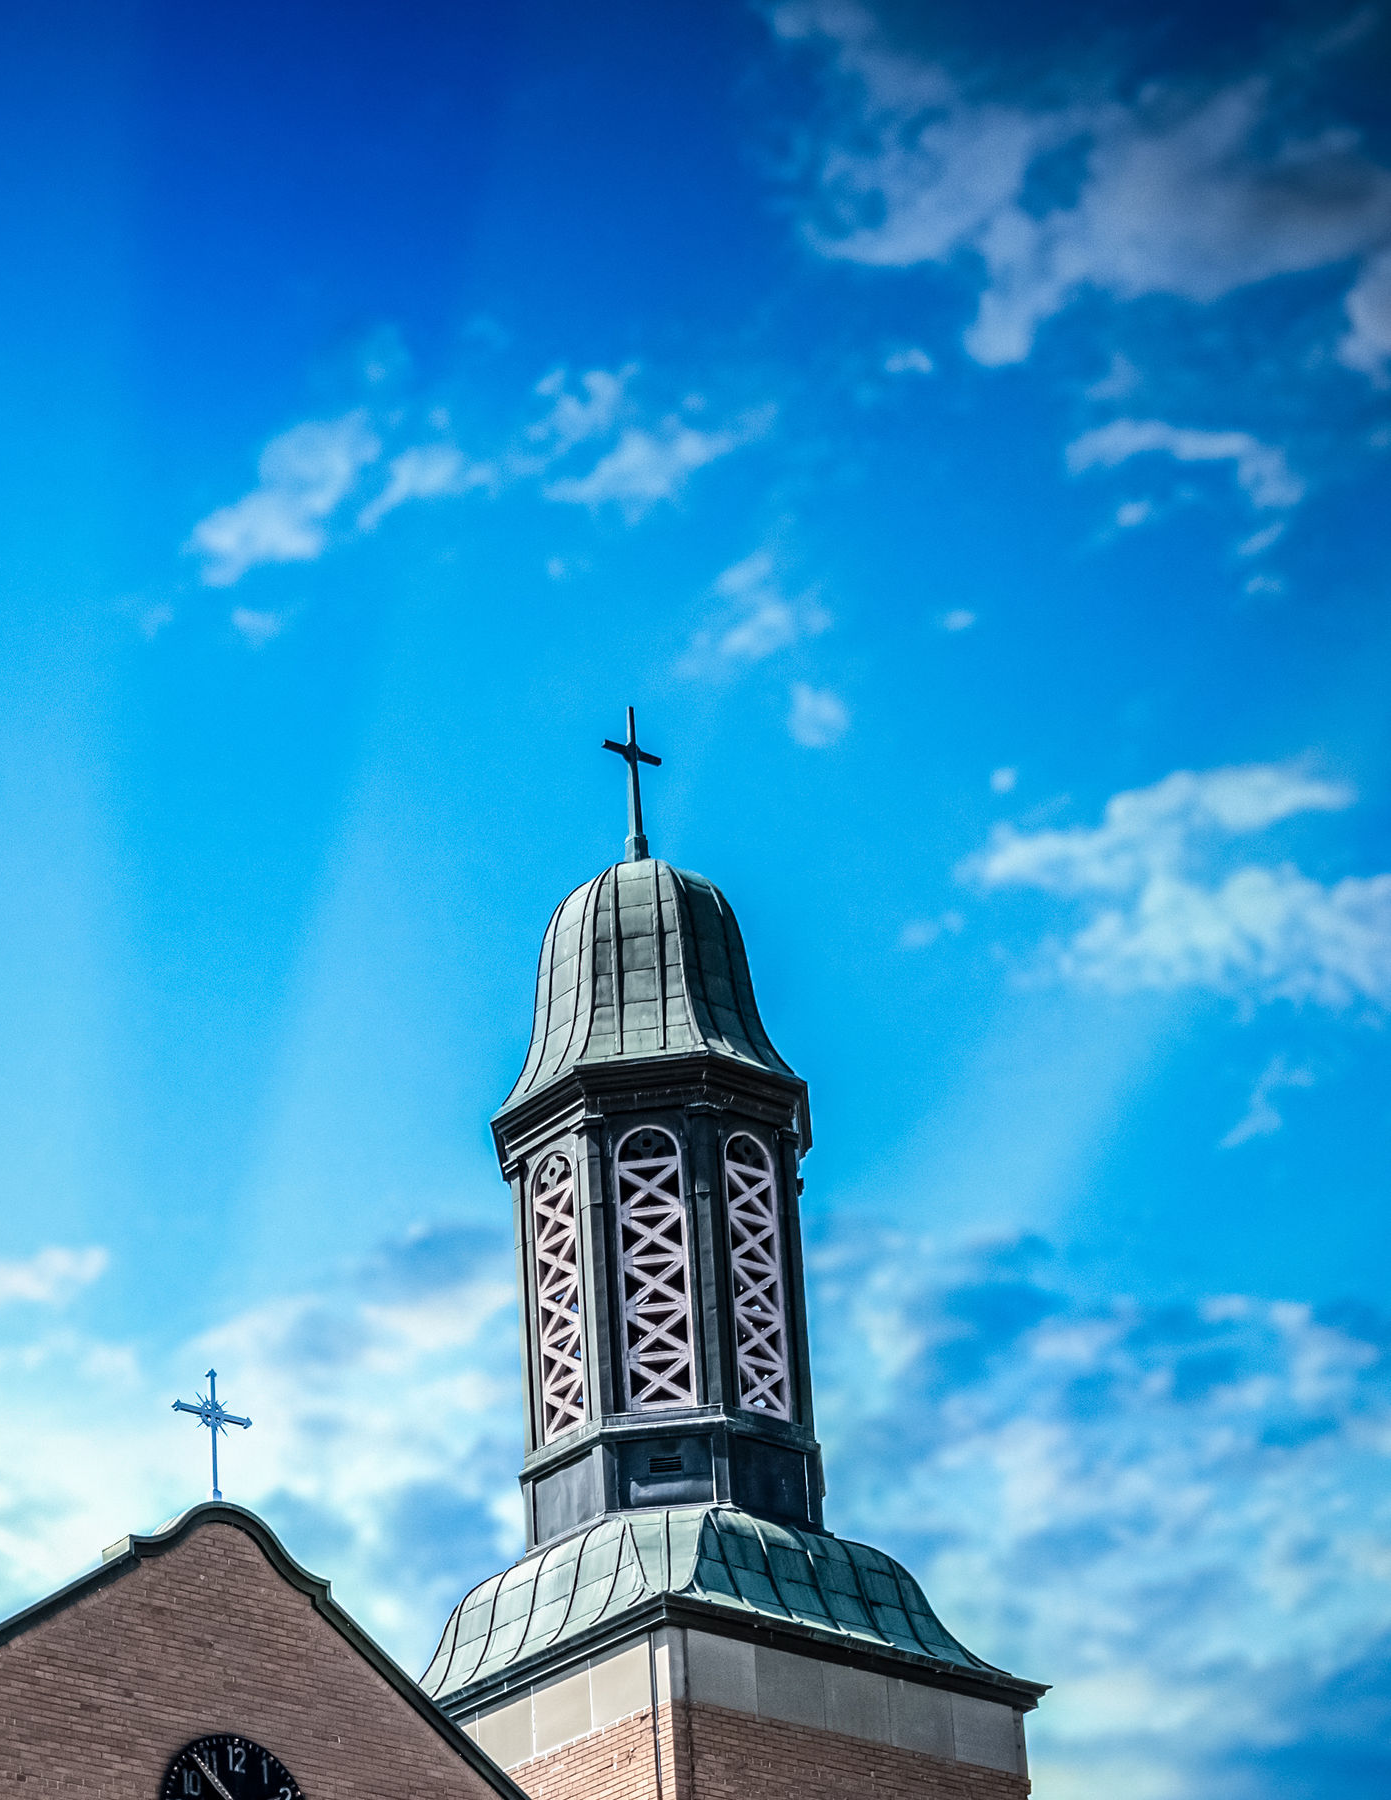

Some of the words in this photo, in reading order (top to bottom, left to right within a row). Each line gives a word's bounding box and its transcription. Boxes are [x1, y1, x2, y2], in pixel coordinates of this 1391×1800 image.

[202, 1750, 218, 1777] 11
[226, 1745, 247, 1774] 12
[262, 1759, 268, 1785] 1
[182, 1768, 201, 1796] 10
